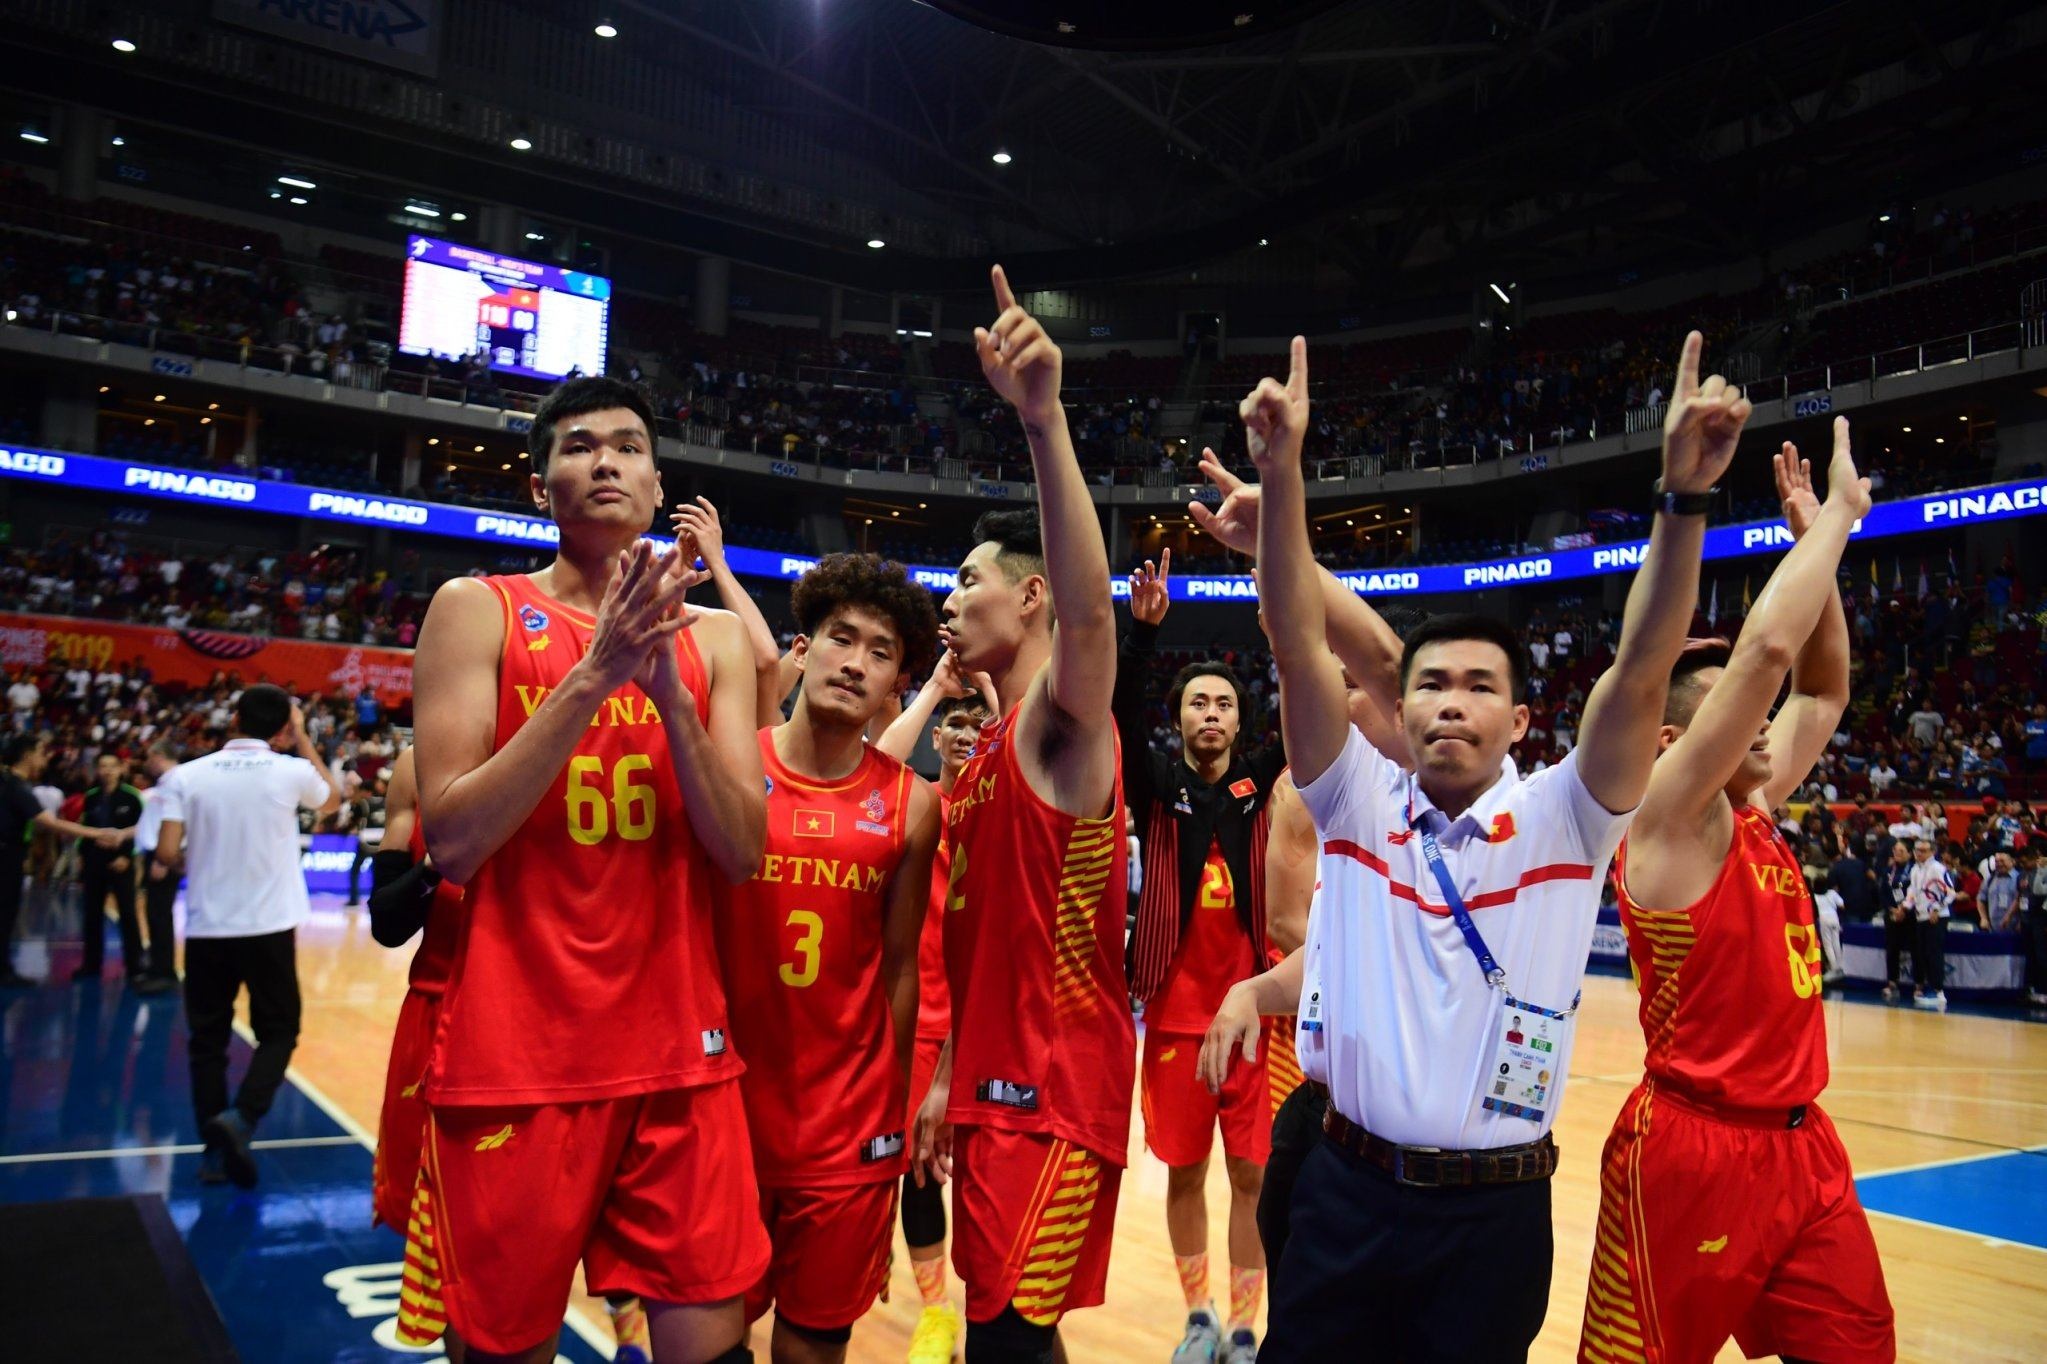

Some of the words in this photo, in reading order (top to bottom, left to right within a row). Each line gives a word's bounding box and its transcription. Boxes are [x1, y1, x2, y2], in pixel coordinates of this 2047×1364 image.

[1797, 396, 1831, 416] 405
[0, 450, 65, 476] ACO
[772, 463, 798, 478] 402
[1521, 456, 1546, 472] 404
[125, 467, 256, 502] PINACO
[309, 492, 428, 525] PINACO
[1924, 486, 2047, 523] PINAC
[476, 515, 560, 543] PINAC
[915, 571, 958, 588] PIN
[1337, 572, 1419, 592] INACO
[1464, 558, 1551, 585] PINACO
[48, 631, 114, 670] 2019
[564, 754, 656, 845] 66
[1425, 844, 1441, 864] ONE
[778, 909, 824, 988] 3
[1004, 1082, 1017, 1092] XL
